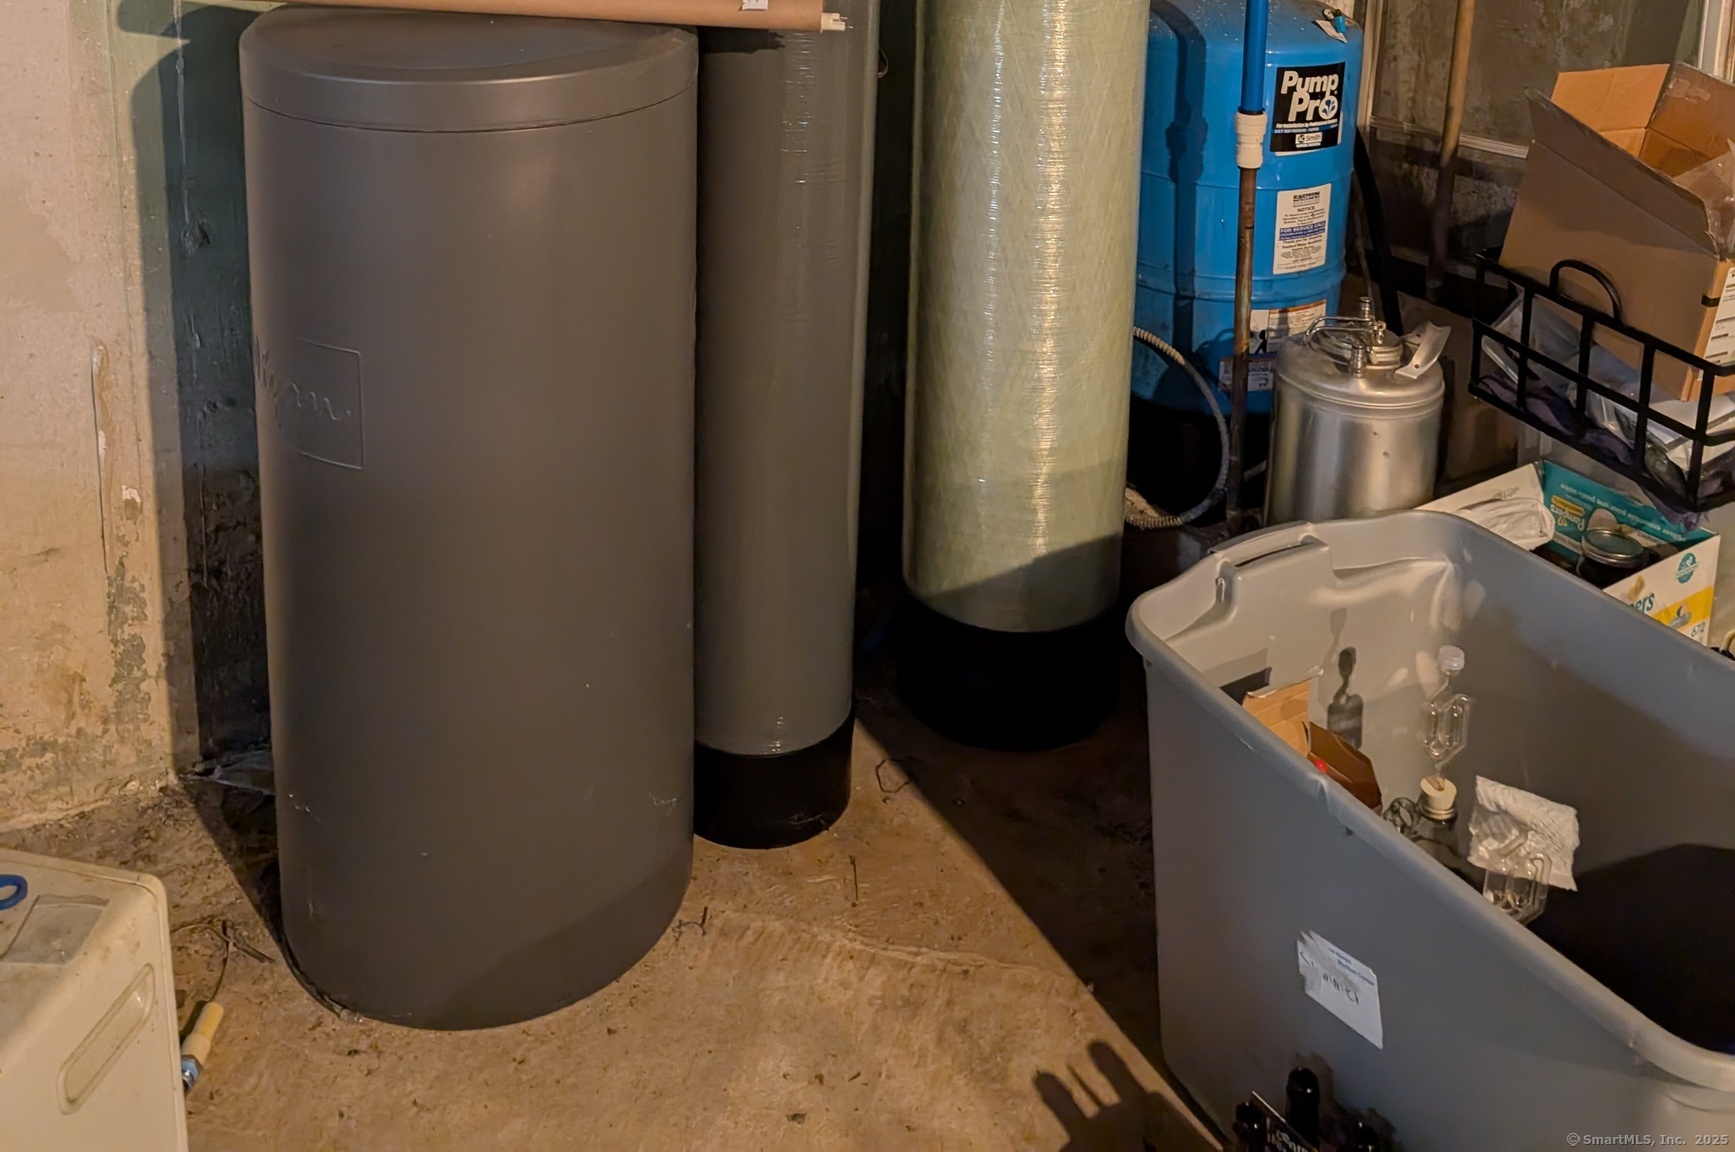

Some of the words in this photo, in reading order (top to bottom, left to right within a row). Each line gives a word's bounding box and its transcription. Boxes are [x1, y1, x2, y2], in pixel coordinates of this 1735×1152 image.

[1280, 70, 1339, 97] Pump
[1288, 91, 1338, 122] Pro
[1550, 504, 1585, 531] Pampers
